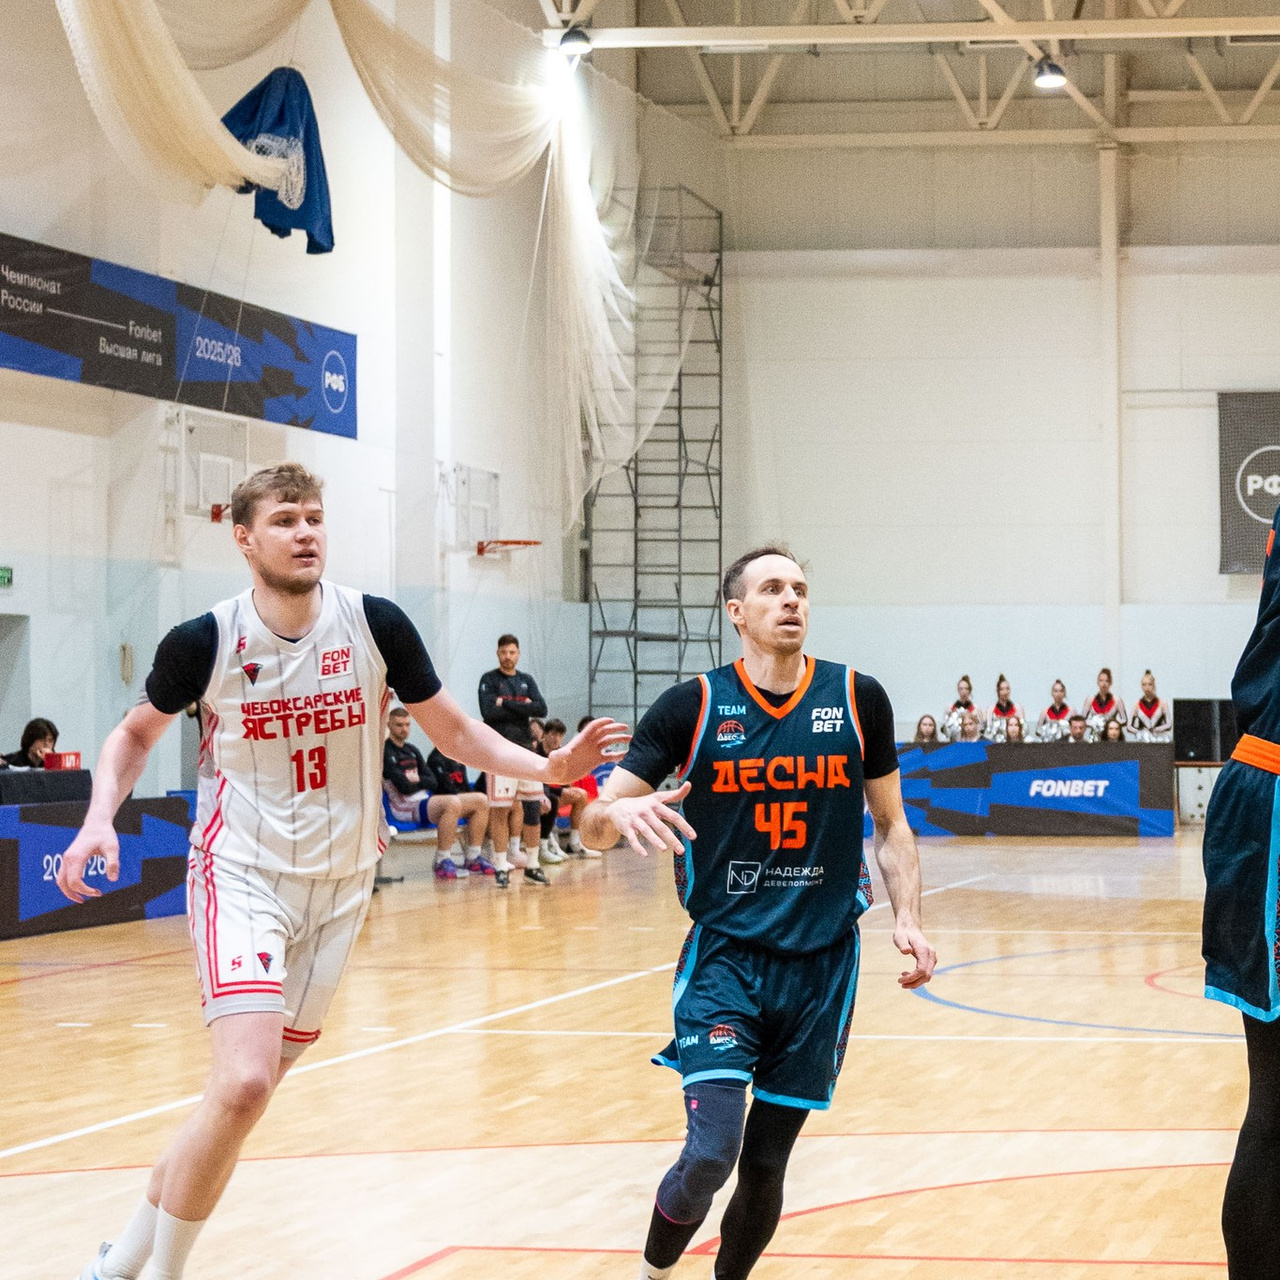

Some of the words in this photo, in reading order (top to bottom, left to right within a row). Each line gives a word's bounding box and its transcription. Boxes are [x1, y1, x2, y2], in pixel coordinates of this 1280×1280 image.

[1, 263, 62, 296] Чемпионат
[1, 289, 44, 315] России
[128, 320, 163, 343] Fonbet
[99, 336, 138, 361] Высшая
[195, 336, 242, 367] 2025/26
[322, 647, 351, 664] FON
[321, 660, 350, 677] BET
[240, 686, 363, 717] ЧЕБОКСАРСКИЕ
[717, 704, 747, 716] TEAM
[811, 706, 844, 720] FON
[240, 701, 366, 741] ЯСТРЕБЫ
[812, 720, 844, 733] BET
[291, 745, 327, 793] 13
[711, 754, 851, 793] ДЕСНА
[1029, 779, 1110, 798] FONBET
[754, 801, 808, 851] 45
[43, 853, 107, 881] 20/26
[765, 866, 825, 878] НАДЕЖДА
